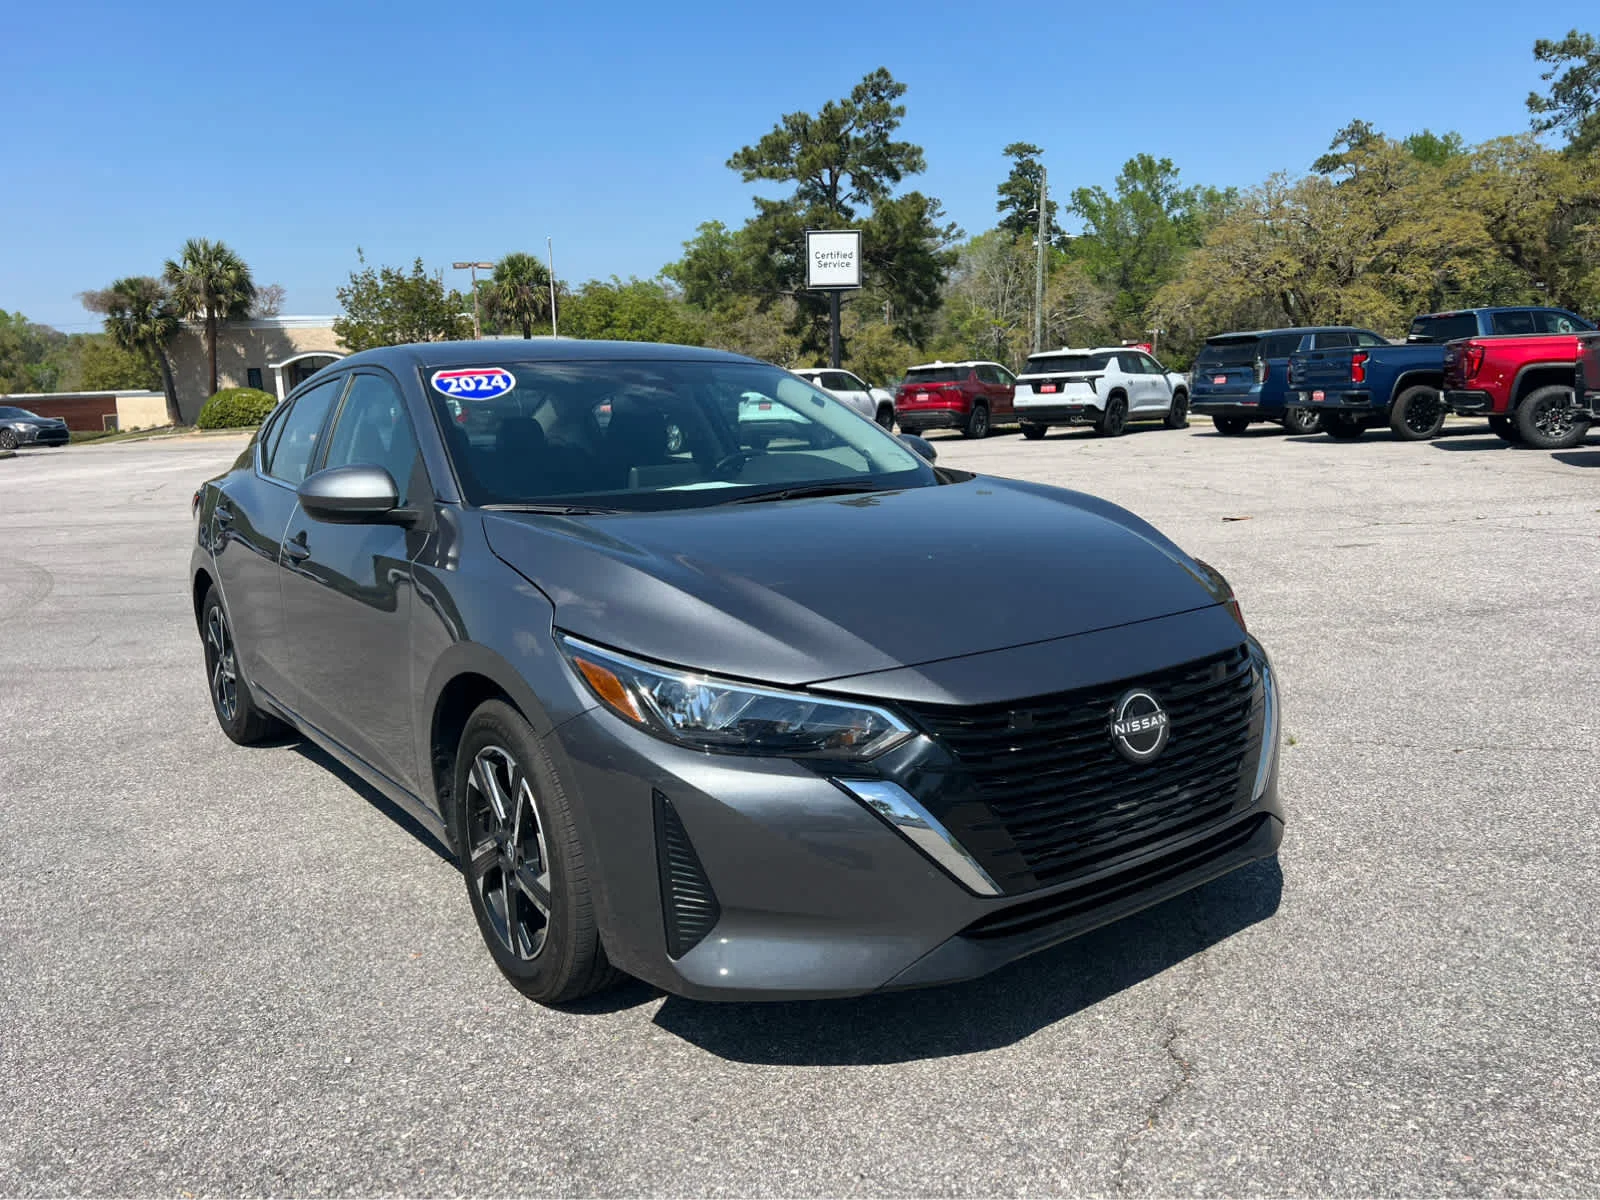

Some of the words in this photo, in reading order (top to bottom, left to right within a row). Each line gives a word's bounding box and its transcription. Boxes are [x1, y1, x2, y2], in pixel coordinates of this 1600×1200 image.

[815, 251, 853, 260] Certified
[817, 260, 851, 268] Service
[443, 375, 507, 393] 2024
[1114, 713, 1166, 735] NISSAN
